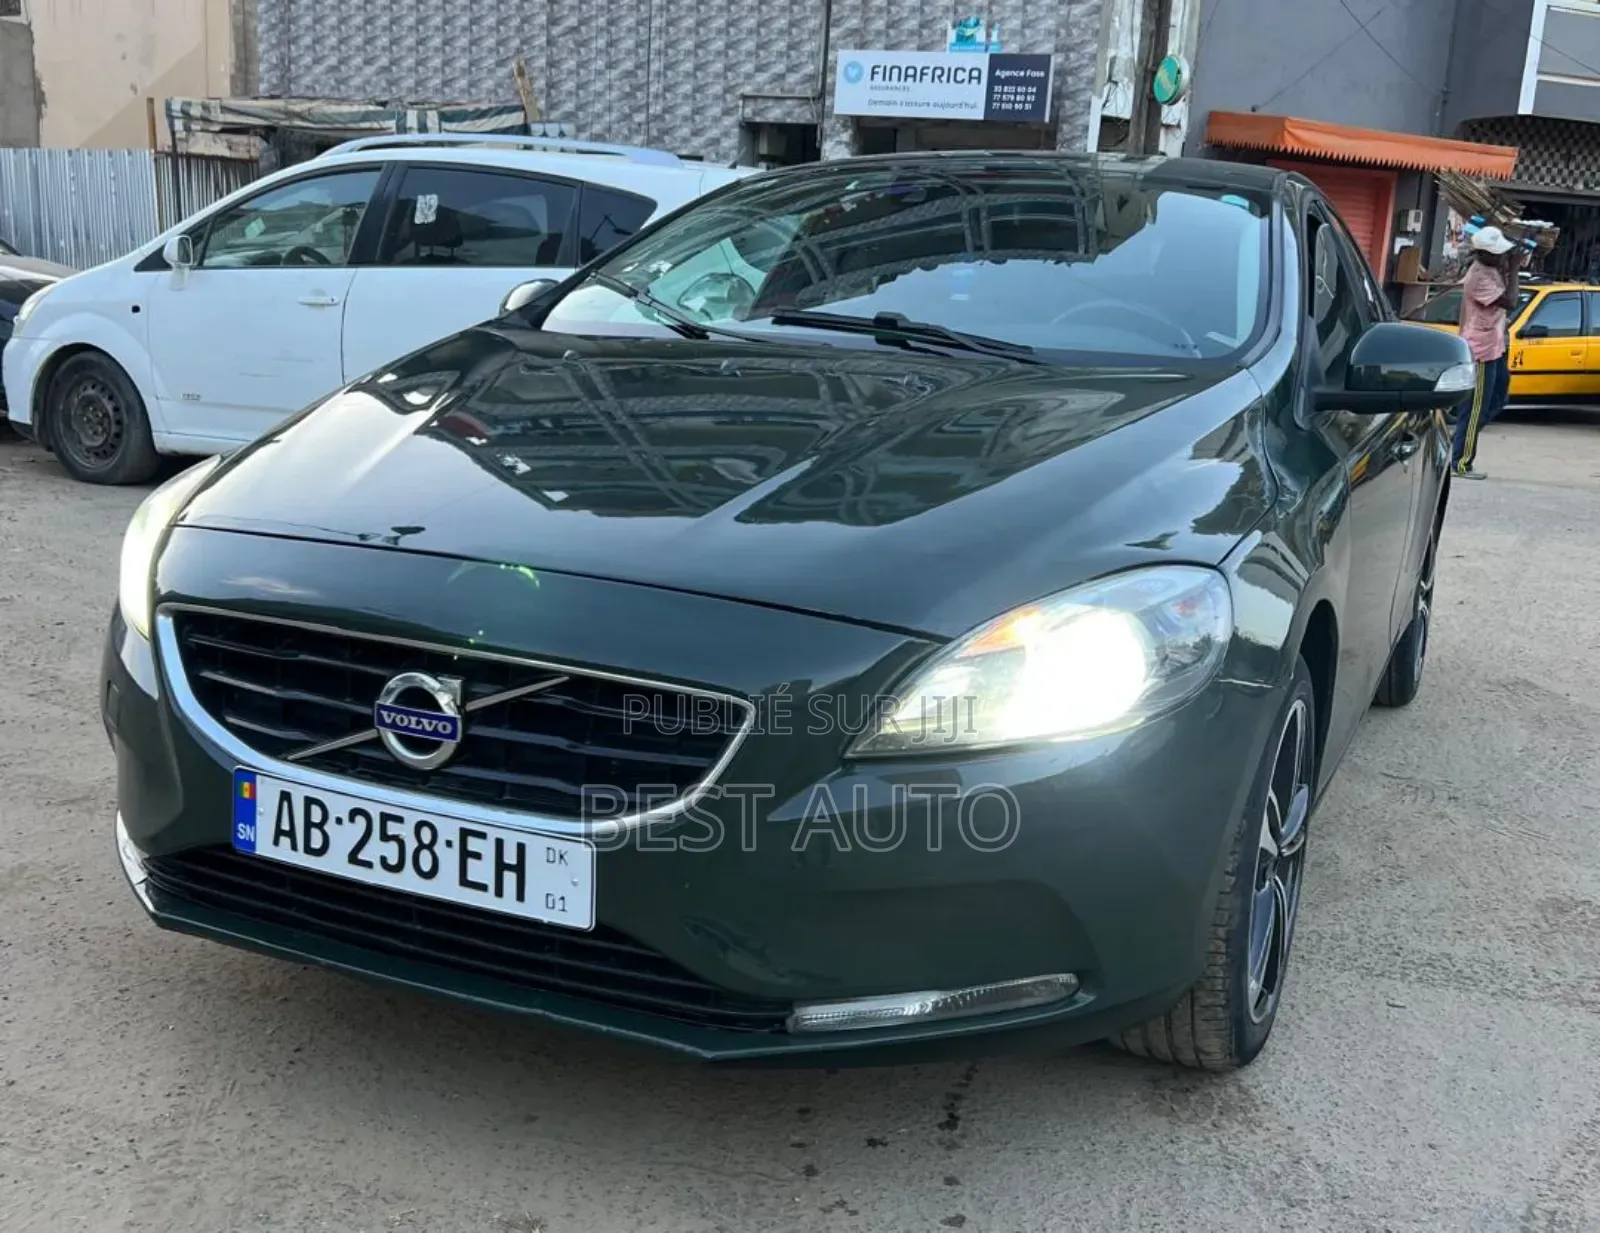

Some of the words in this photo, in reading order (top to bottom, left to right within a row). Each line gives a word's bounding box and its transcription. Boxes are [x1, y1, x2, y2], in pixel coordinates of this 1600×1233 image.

[870, 65, 982, 85] FINAFRICA
[995, 69, 1025, 79] Agence
[868, 99, 898, 107] Demain
[380, 710, 453, 735] VOLVO
[237, 822, 255, 842] SN
[546, 846, 568, 866] DK
